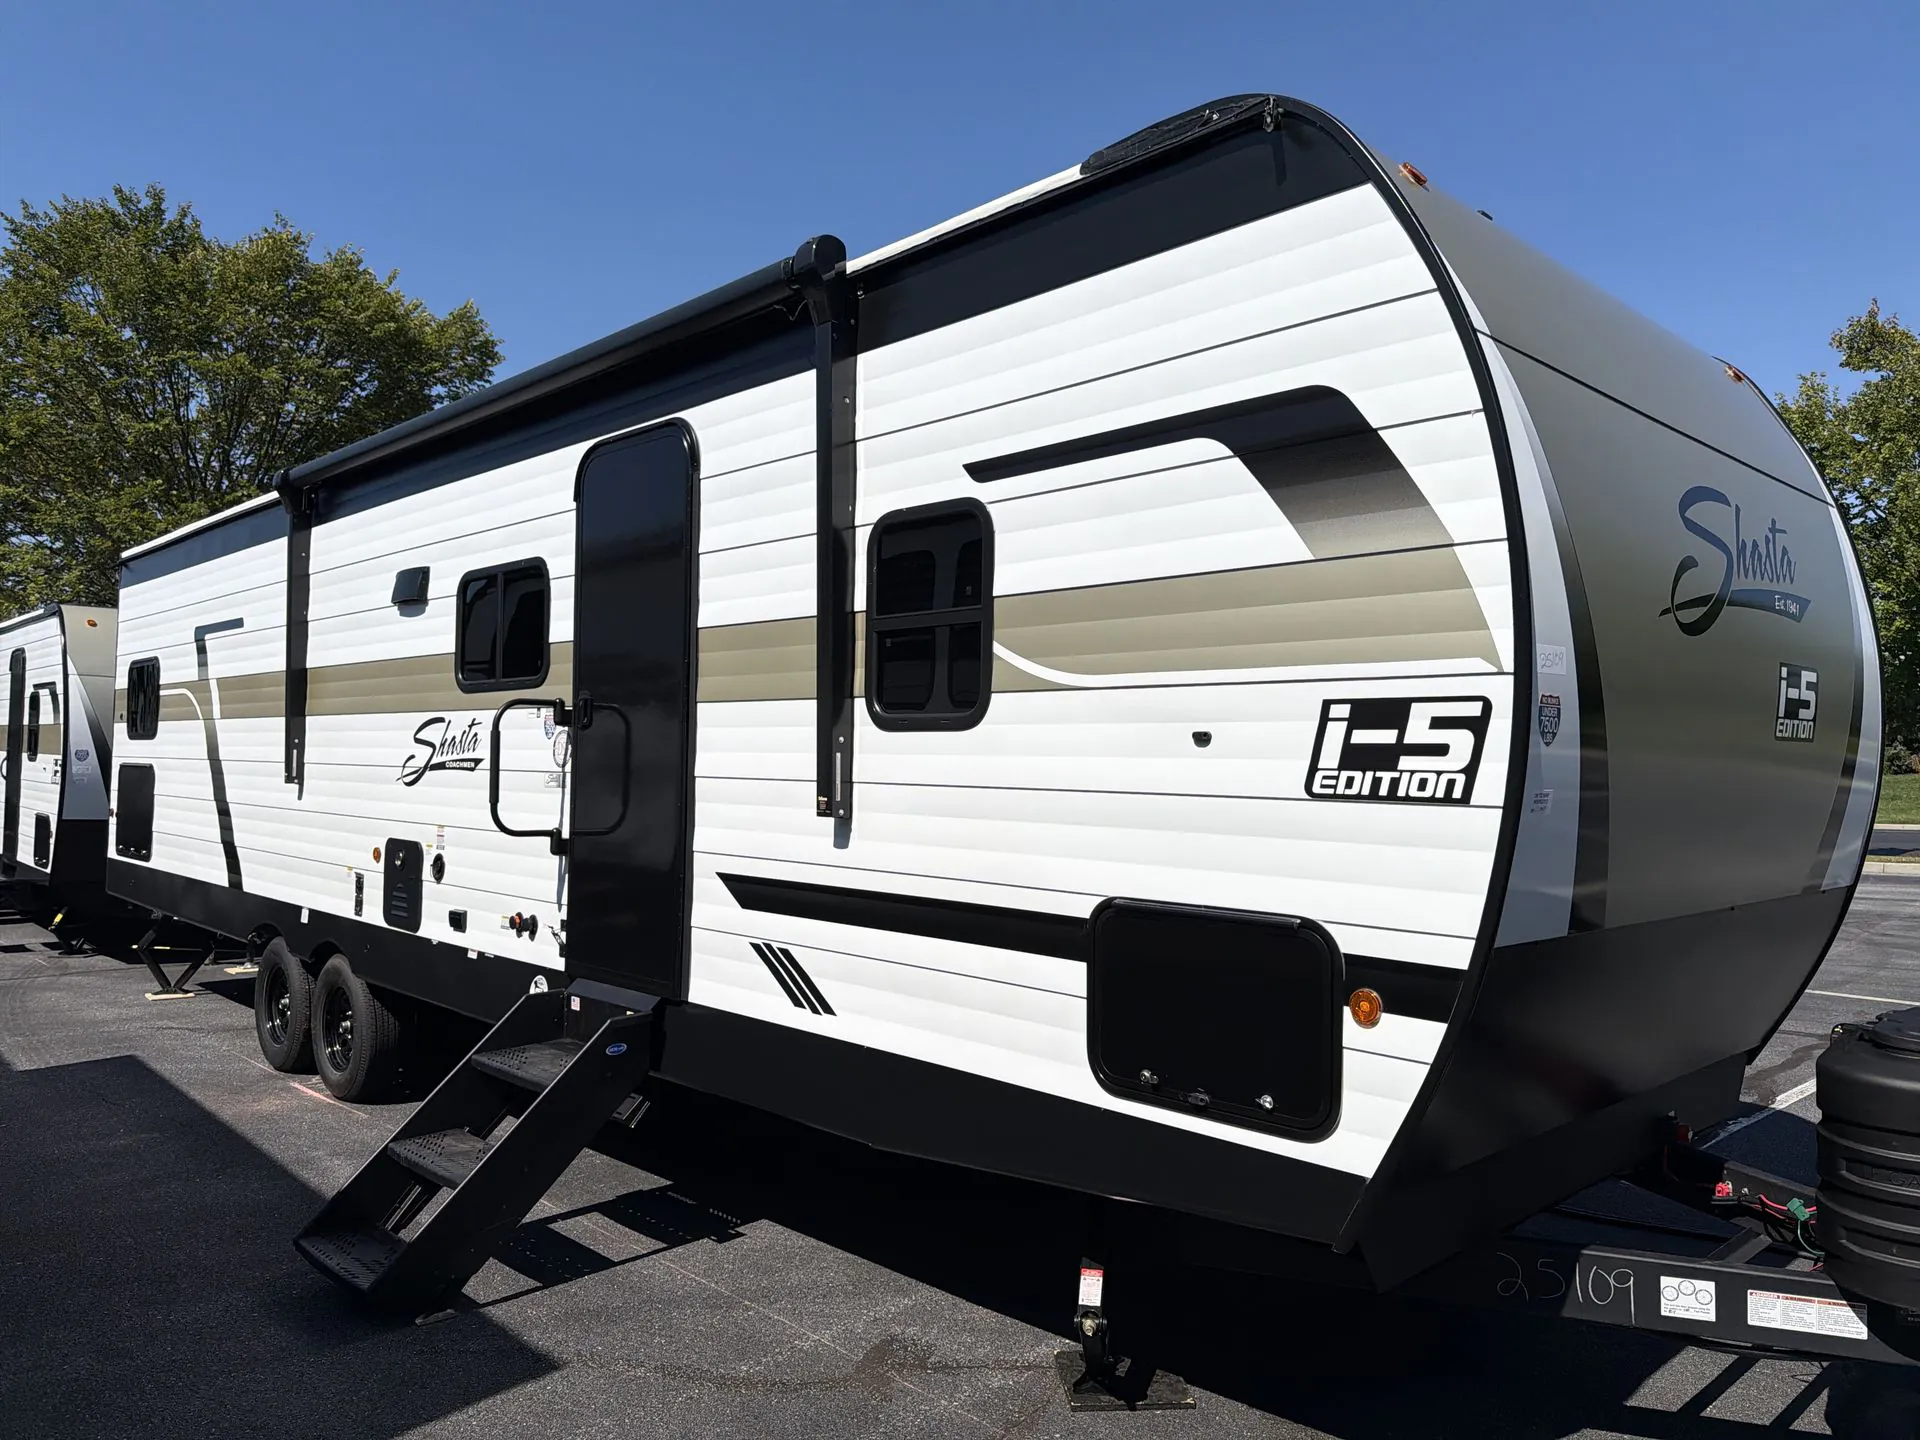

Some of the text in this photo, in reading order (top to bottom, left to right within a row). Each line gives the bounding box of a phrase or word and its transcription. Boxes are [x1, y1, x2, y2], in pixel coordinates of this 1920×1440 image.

[1660, 486, 1798, 636] Shasta
[1786, 599, 1800, 617] 1941
[1541, 706, 1558, 717] UNDER
[1540, 716, 1559, 733] 7500
[1776, 718, 1814, 740] EDITION
[1317, 701, 1483, 771] i-5
[1543, 732, 1553, 743] LBS
[400, 716, 483, 787] Shasta
[445, 761, 475, 769] COACHMEN
[1312, 770, 1467, 799] EDITION
[1497, 1252, 1635, 1325] 25109
